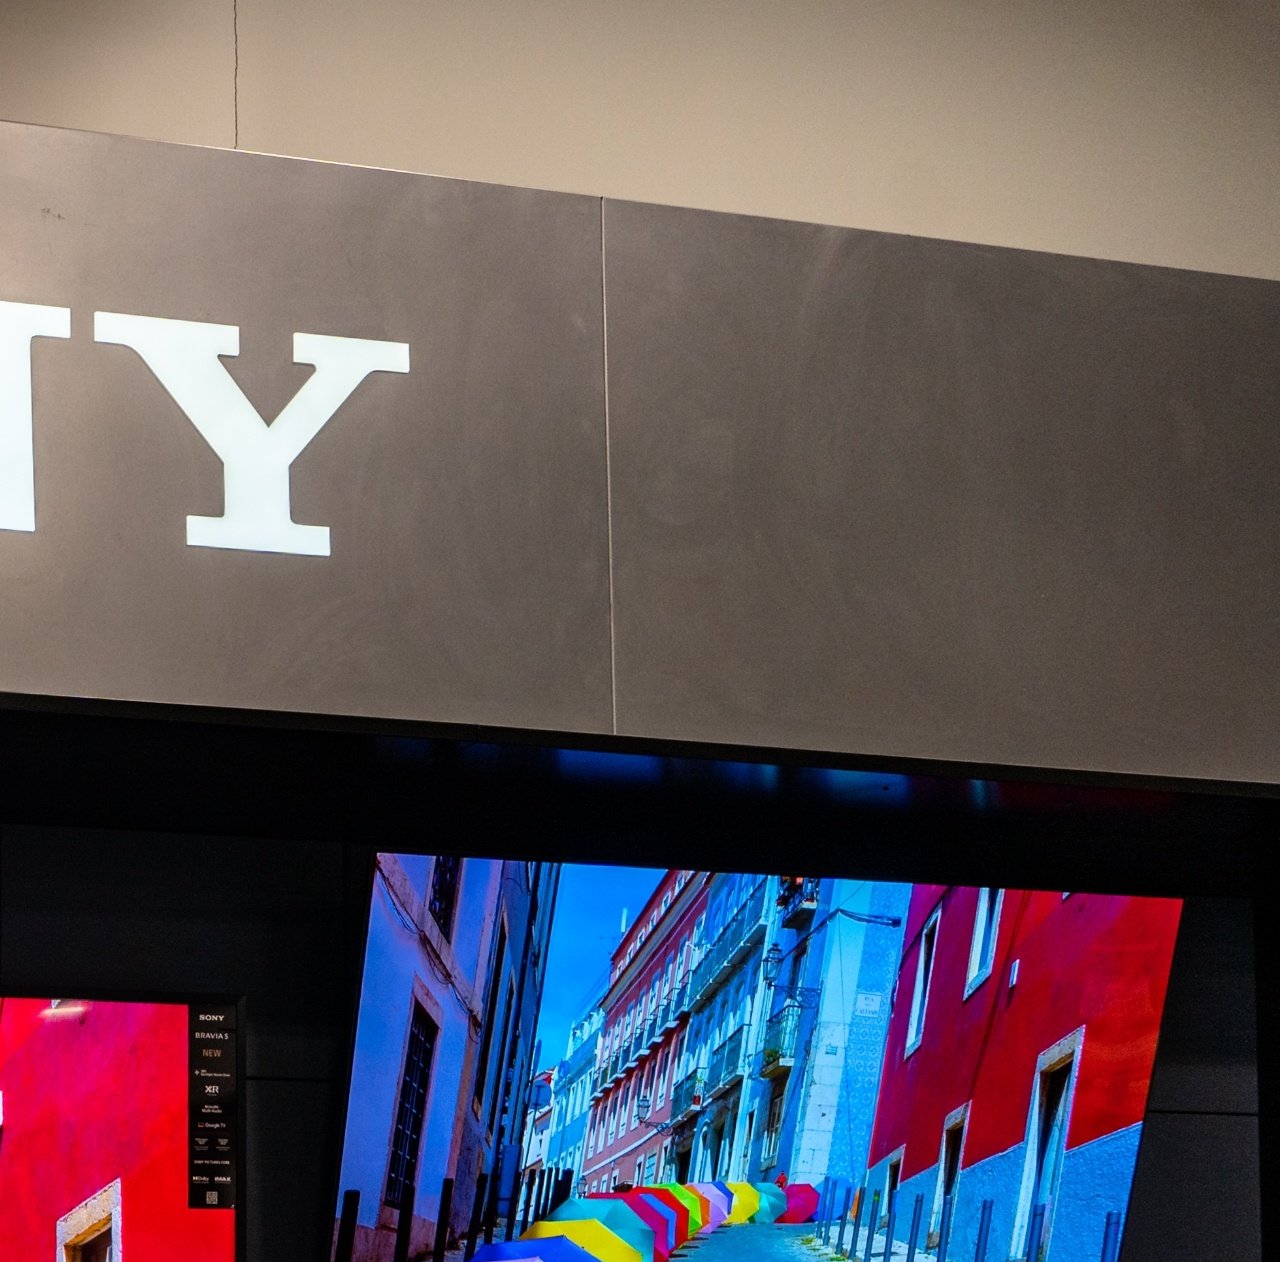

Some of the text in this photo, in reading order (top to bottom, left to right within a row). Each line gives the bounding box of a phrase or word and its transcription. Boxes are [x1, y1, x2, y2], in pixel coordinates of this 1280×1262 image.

[199, 1014, 224, 1022] SONY
[195, 1032, 223, 1040] BRAVIA
[202, 1049, 222, 1058] NEW
